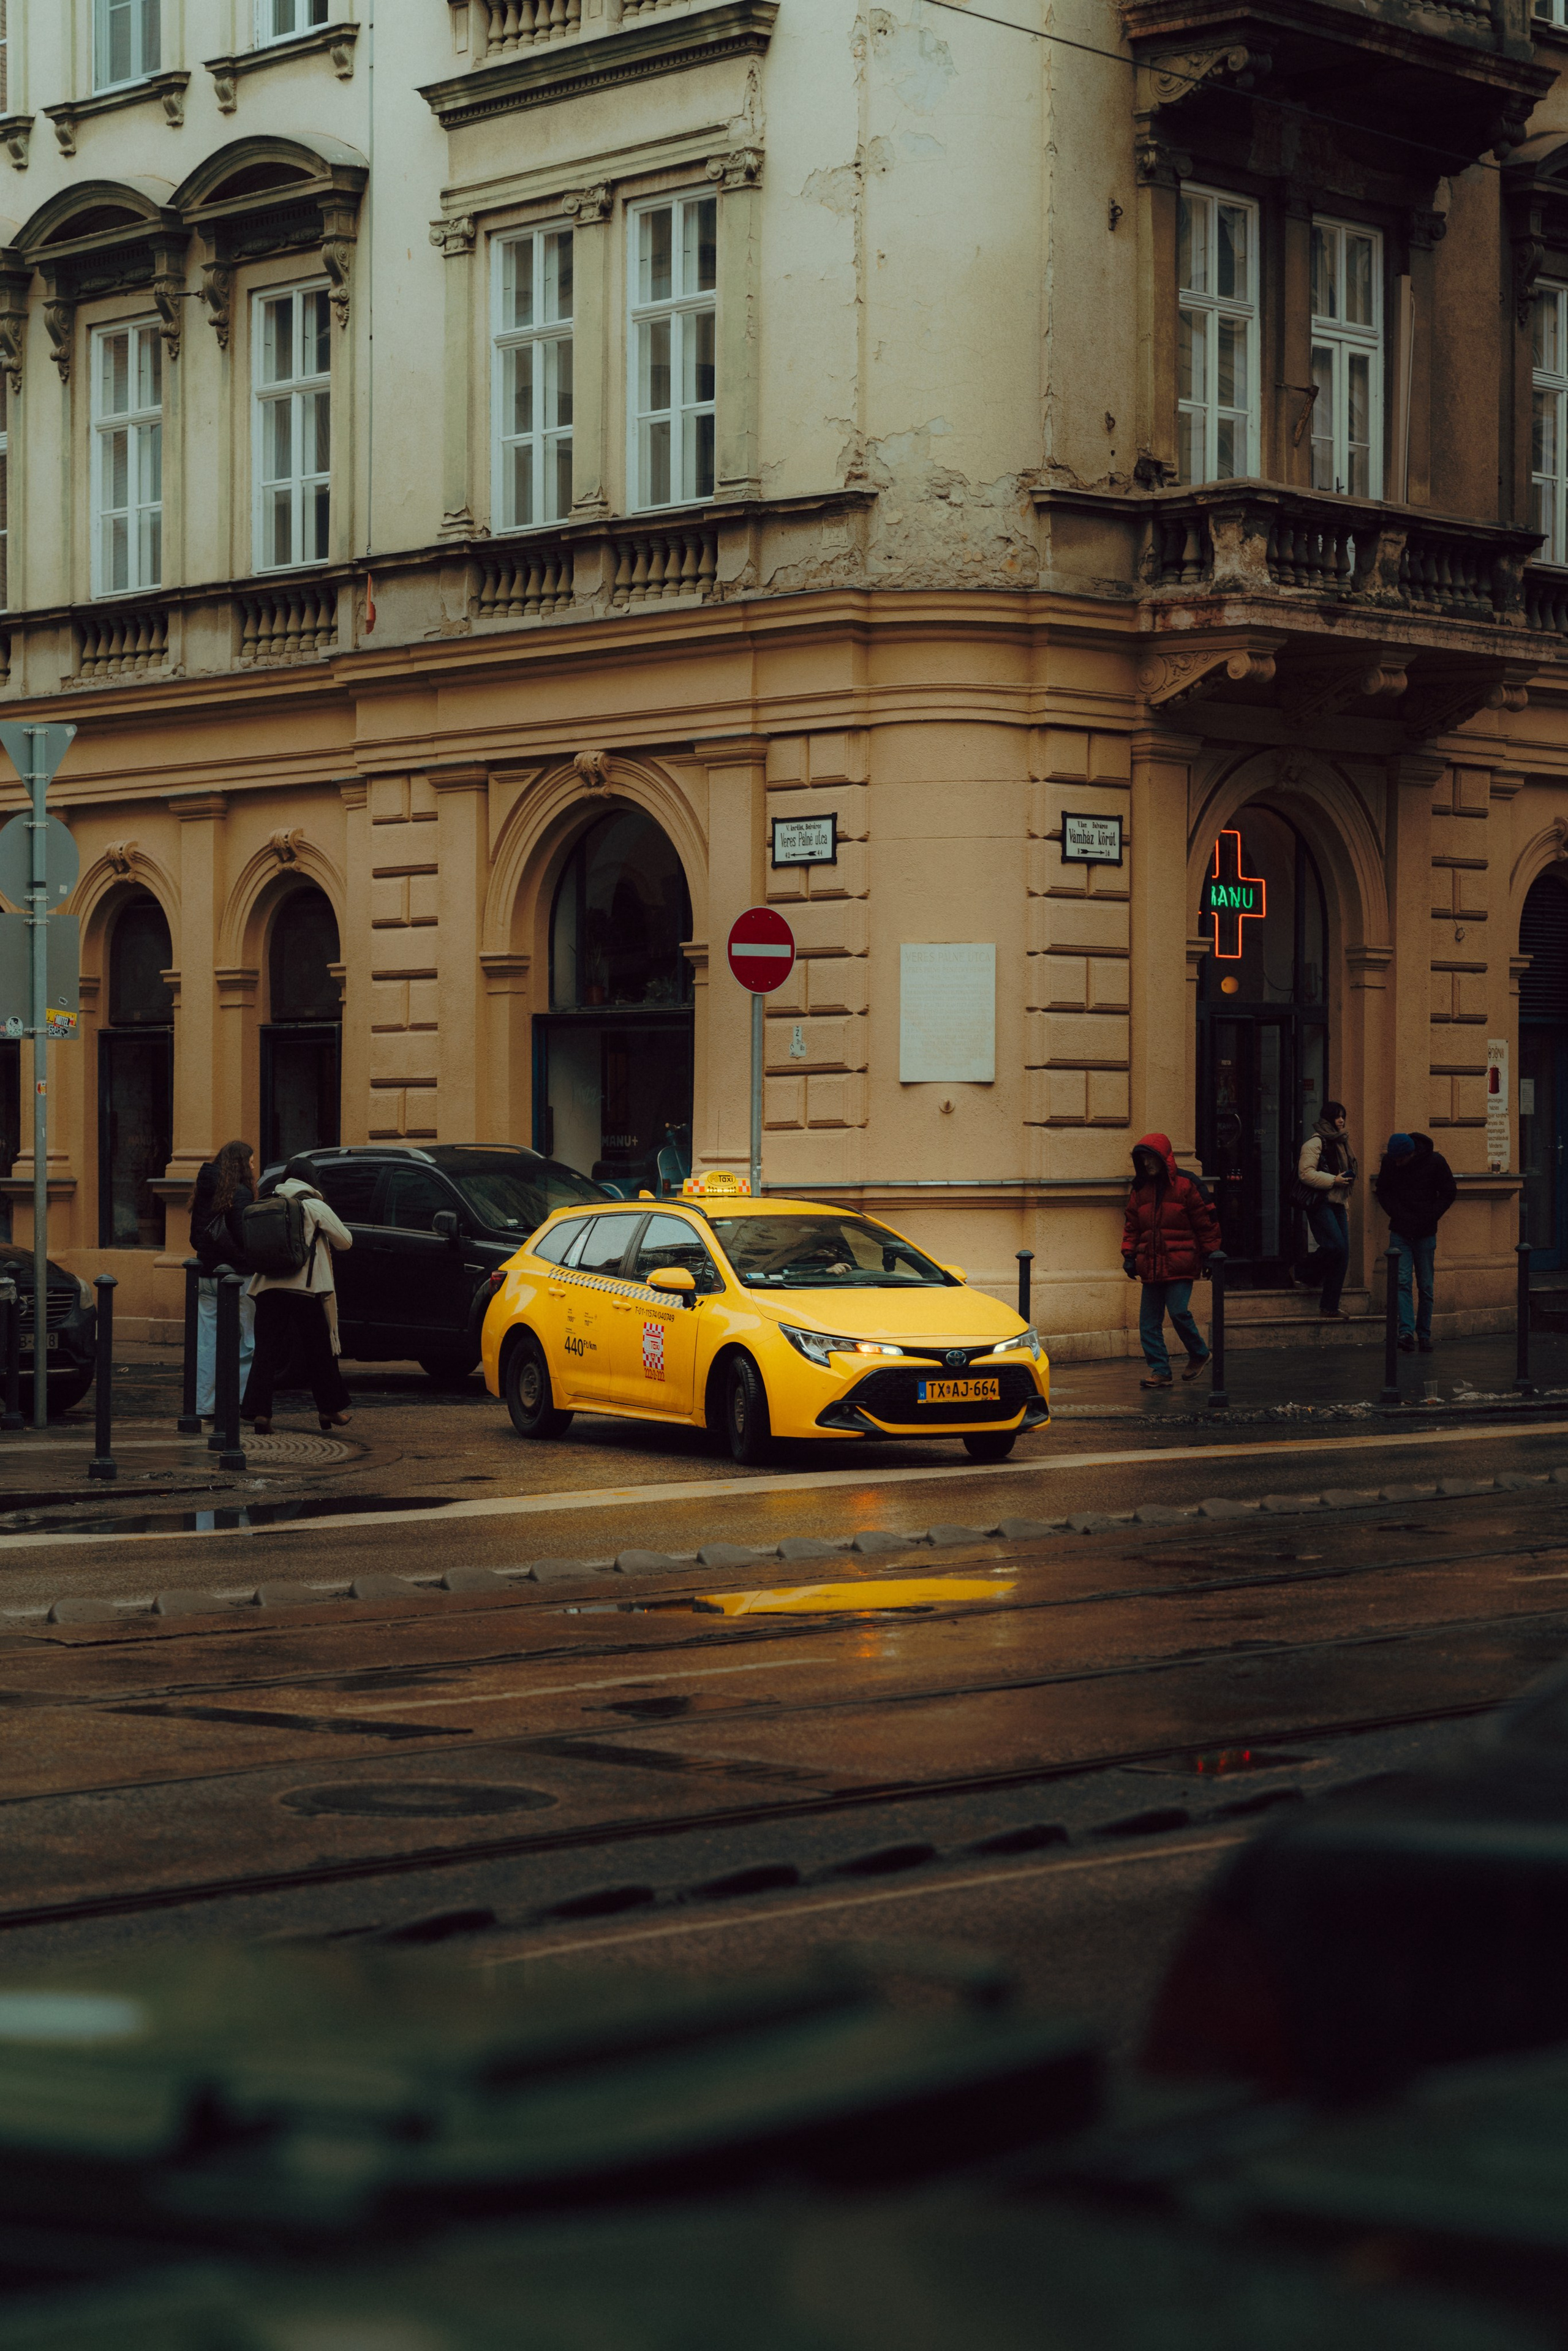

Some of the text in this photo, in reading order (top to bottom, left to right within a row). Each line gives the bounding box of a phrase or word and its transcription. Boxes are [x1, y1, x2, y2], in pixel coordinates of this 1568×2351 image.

[780, 830, 827, 847] Veres Pálné utca
[1069, 828, 1094, 845] Vámház
[905, 952, 935, 962] VERES
[968, 952, 991, 962] UTCA
[565, 1336, 597, 1357] 440 Ft/km
[929, 1380, 997, 1398] TX AJ-664
